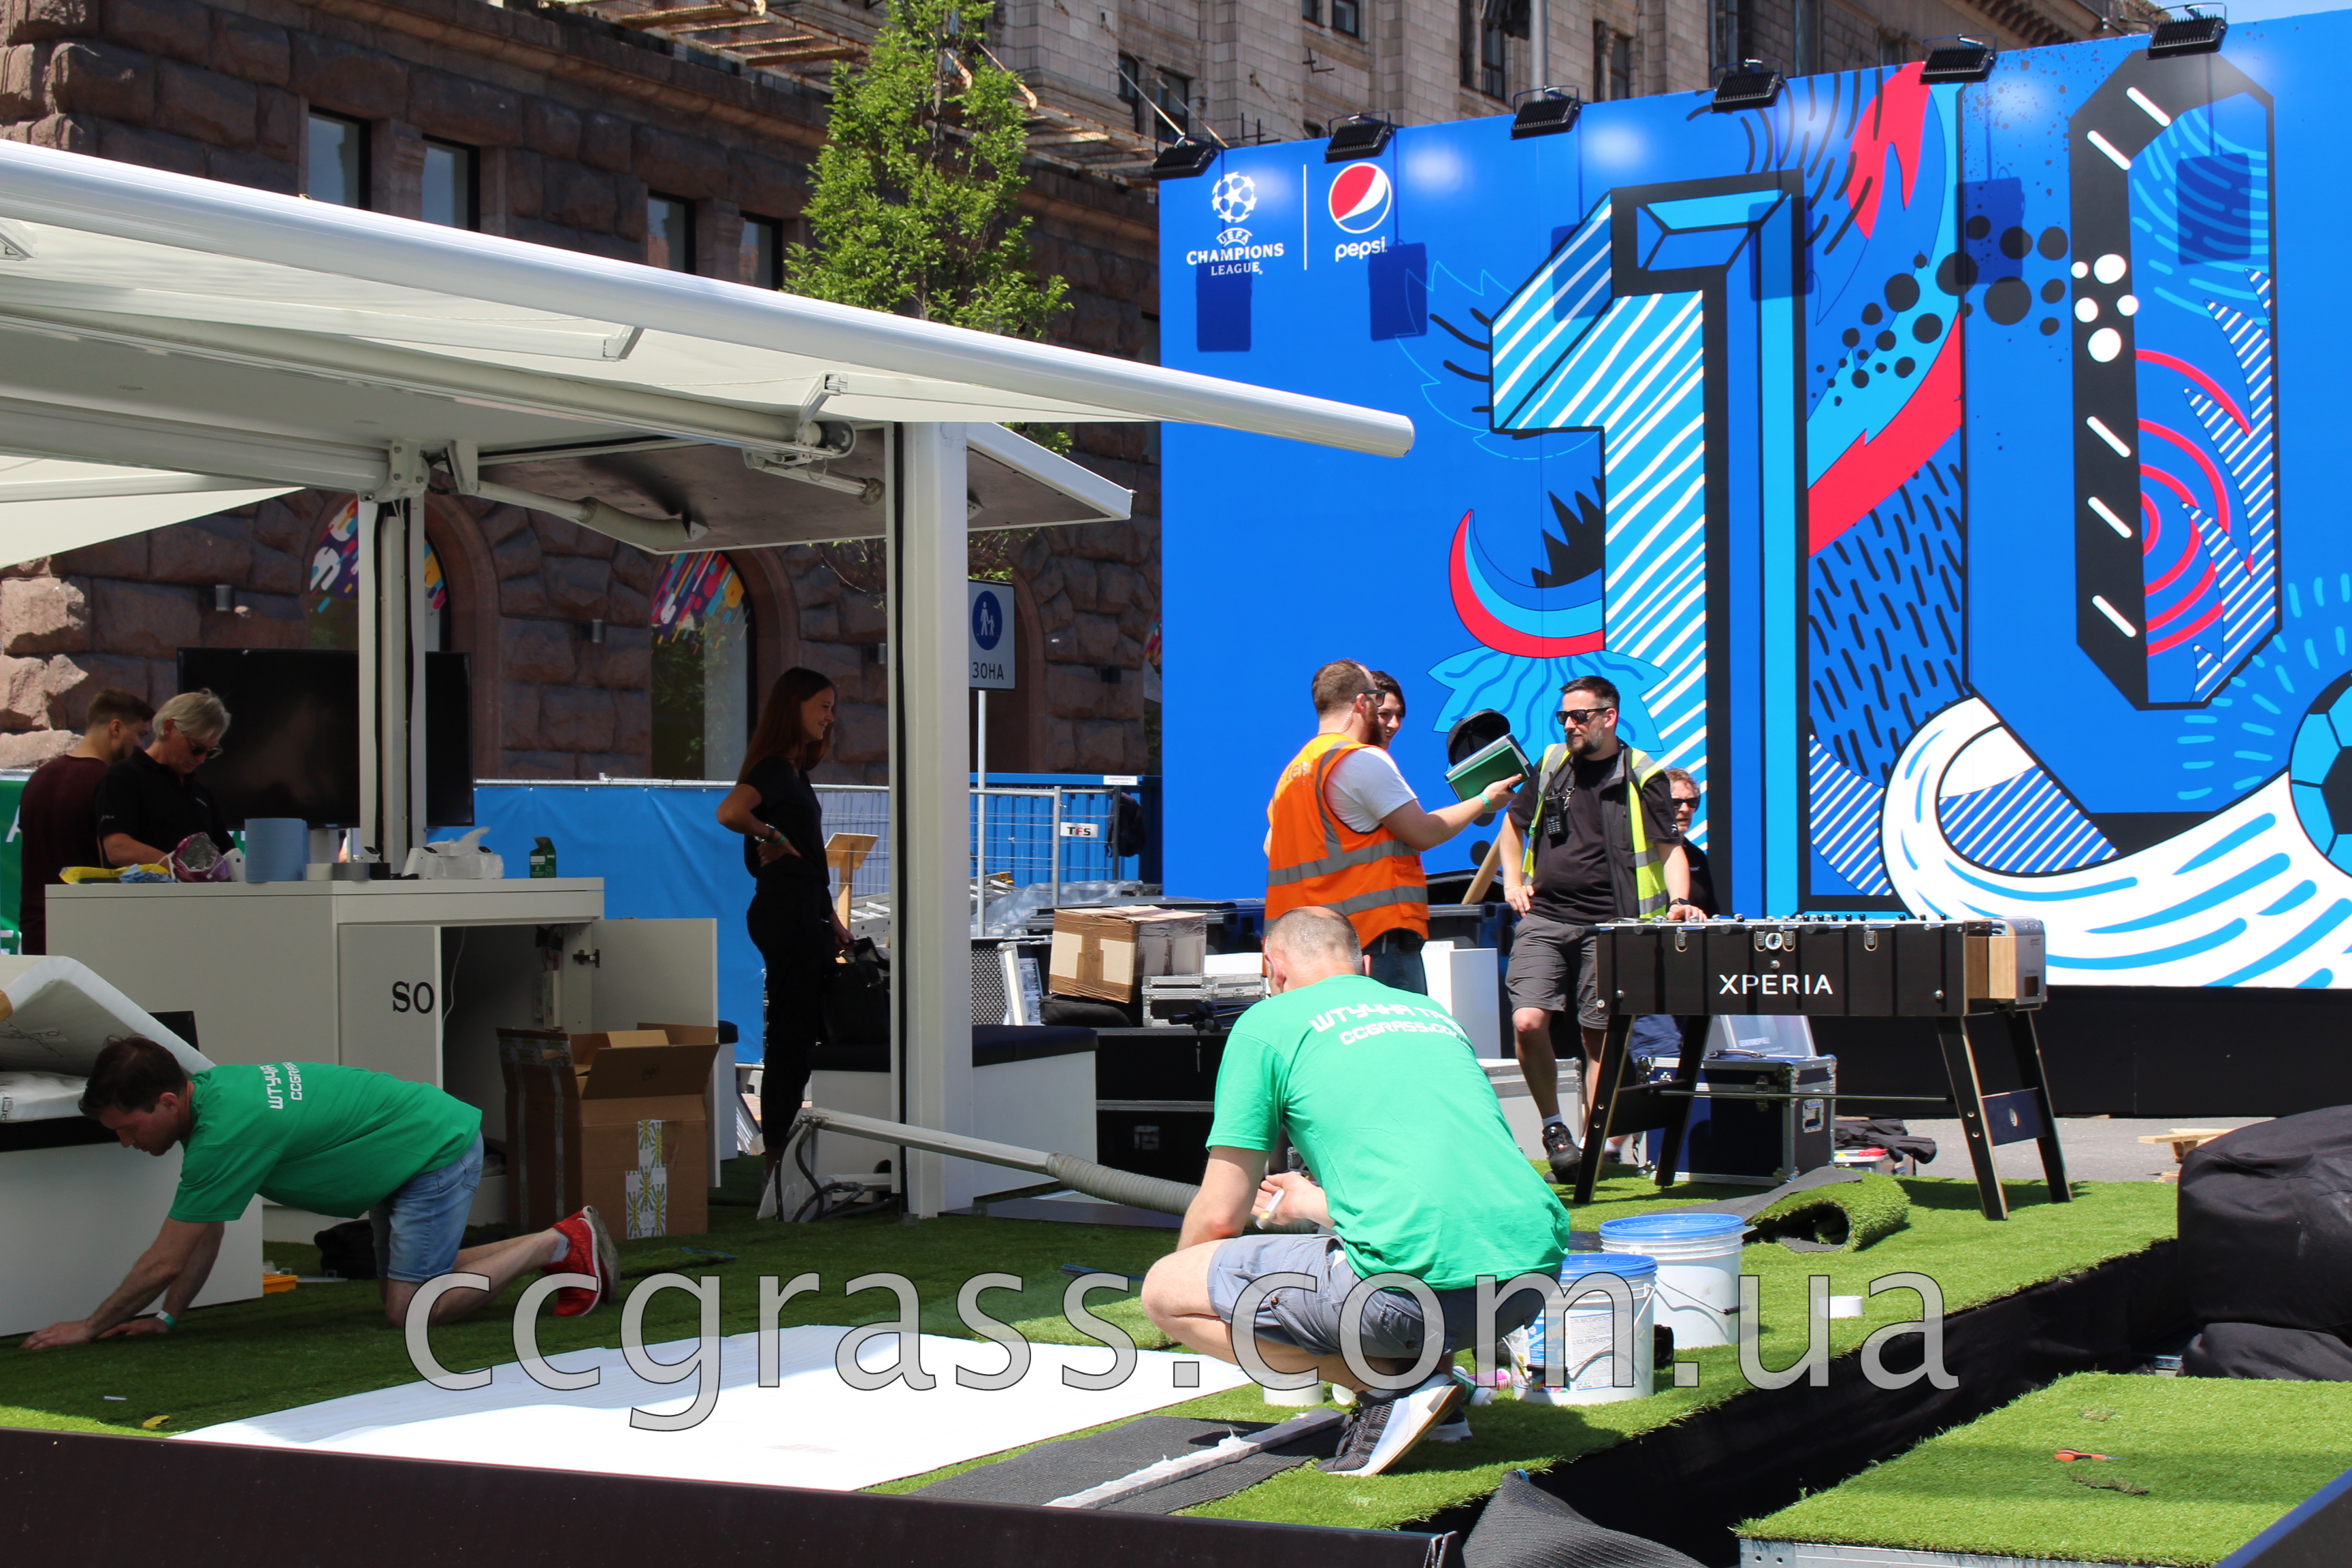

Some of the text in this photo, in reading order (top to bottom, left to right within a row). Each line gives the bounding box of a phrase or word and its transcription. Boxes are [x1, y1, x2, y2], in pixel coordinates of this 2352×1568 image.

[1218, 231, 1250, 244] UEFA
[1186, 243, 1284, 265] CHAMPIONS
[1335, 236, 1385, 261] pepsi
[1211, 261, 1260, 276] LEAGUE
[972, 662, 1004, 681] ЗОНА
[1066, 826, 1091, 836] TFS
[1718, 974, 1833, 995] XPERIA
[392, 981, 434, 1014] SO
[1308, 1004, 1416, 1032] ШТУЧНА
[1339, 1020, 1471, 1051] CCGRASS.CO
